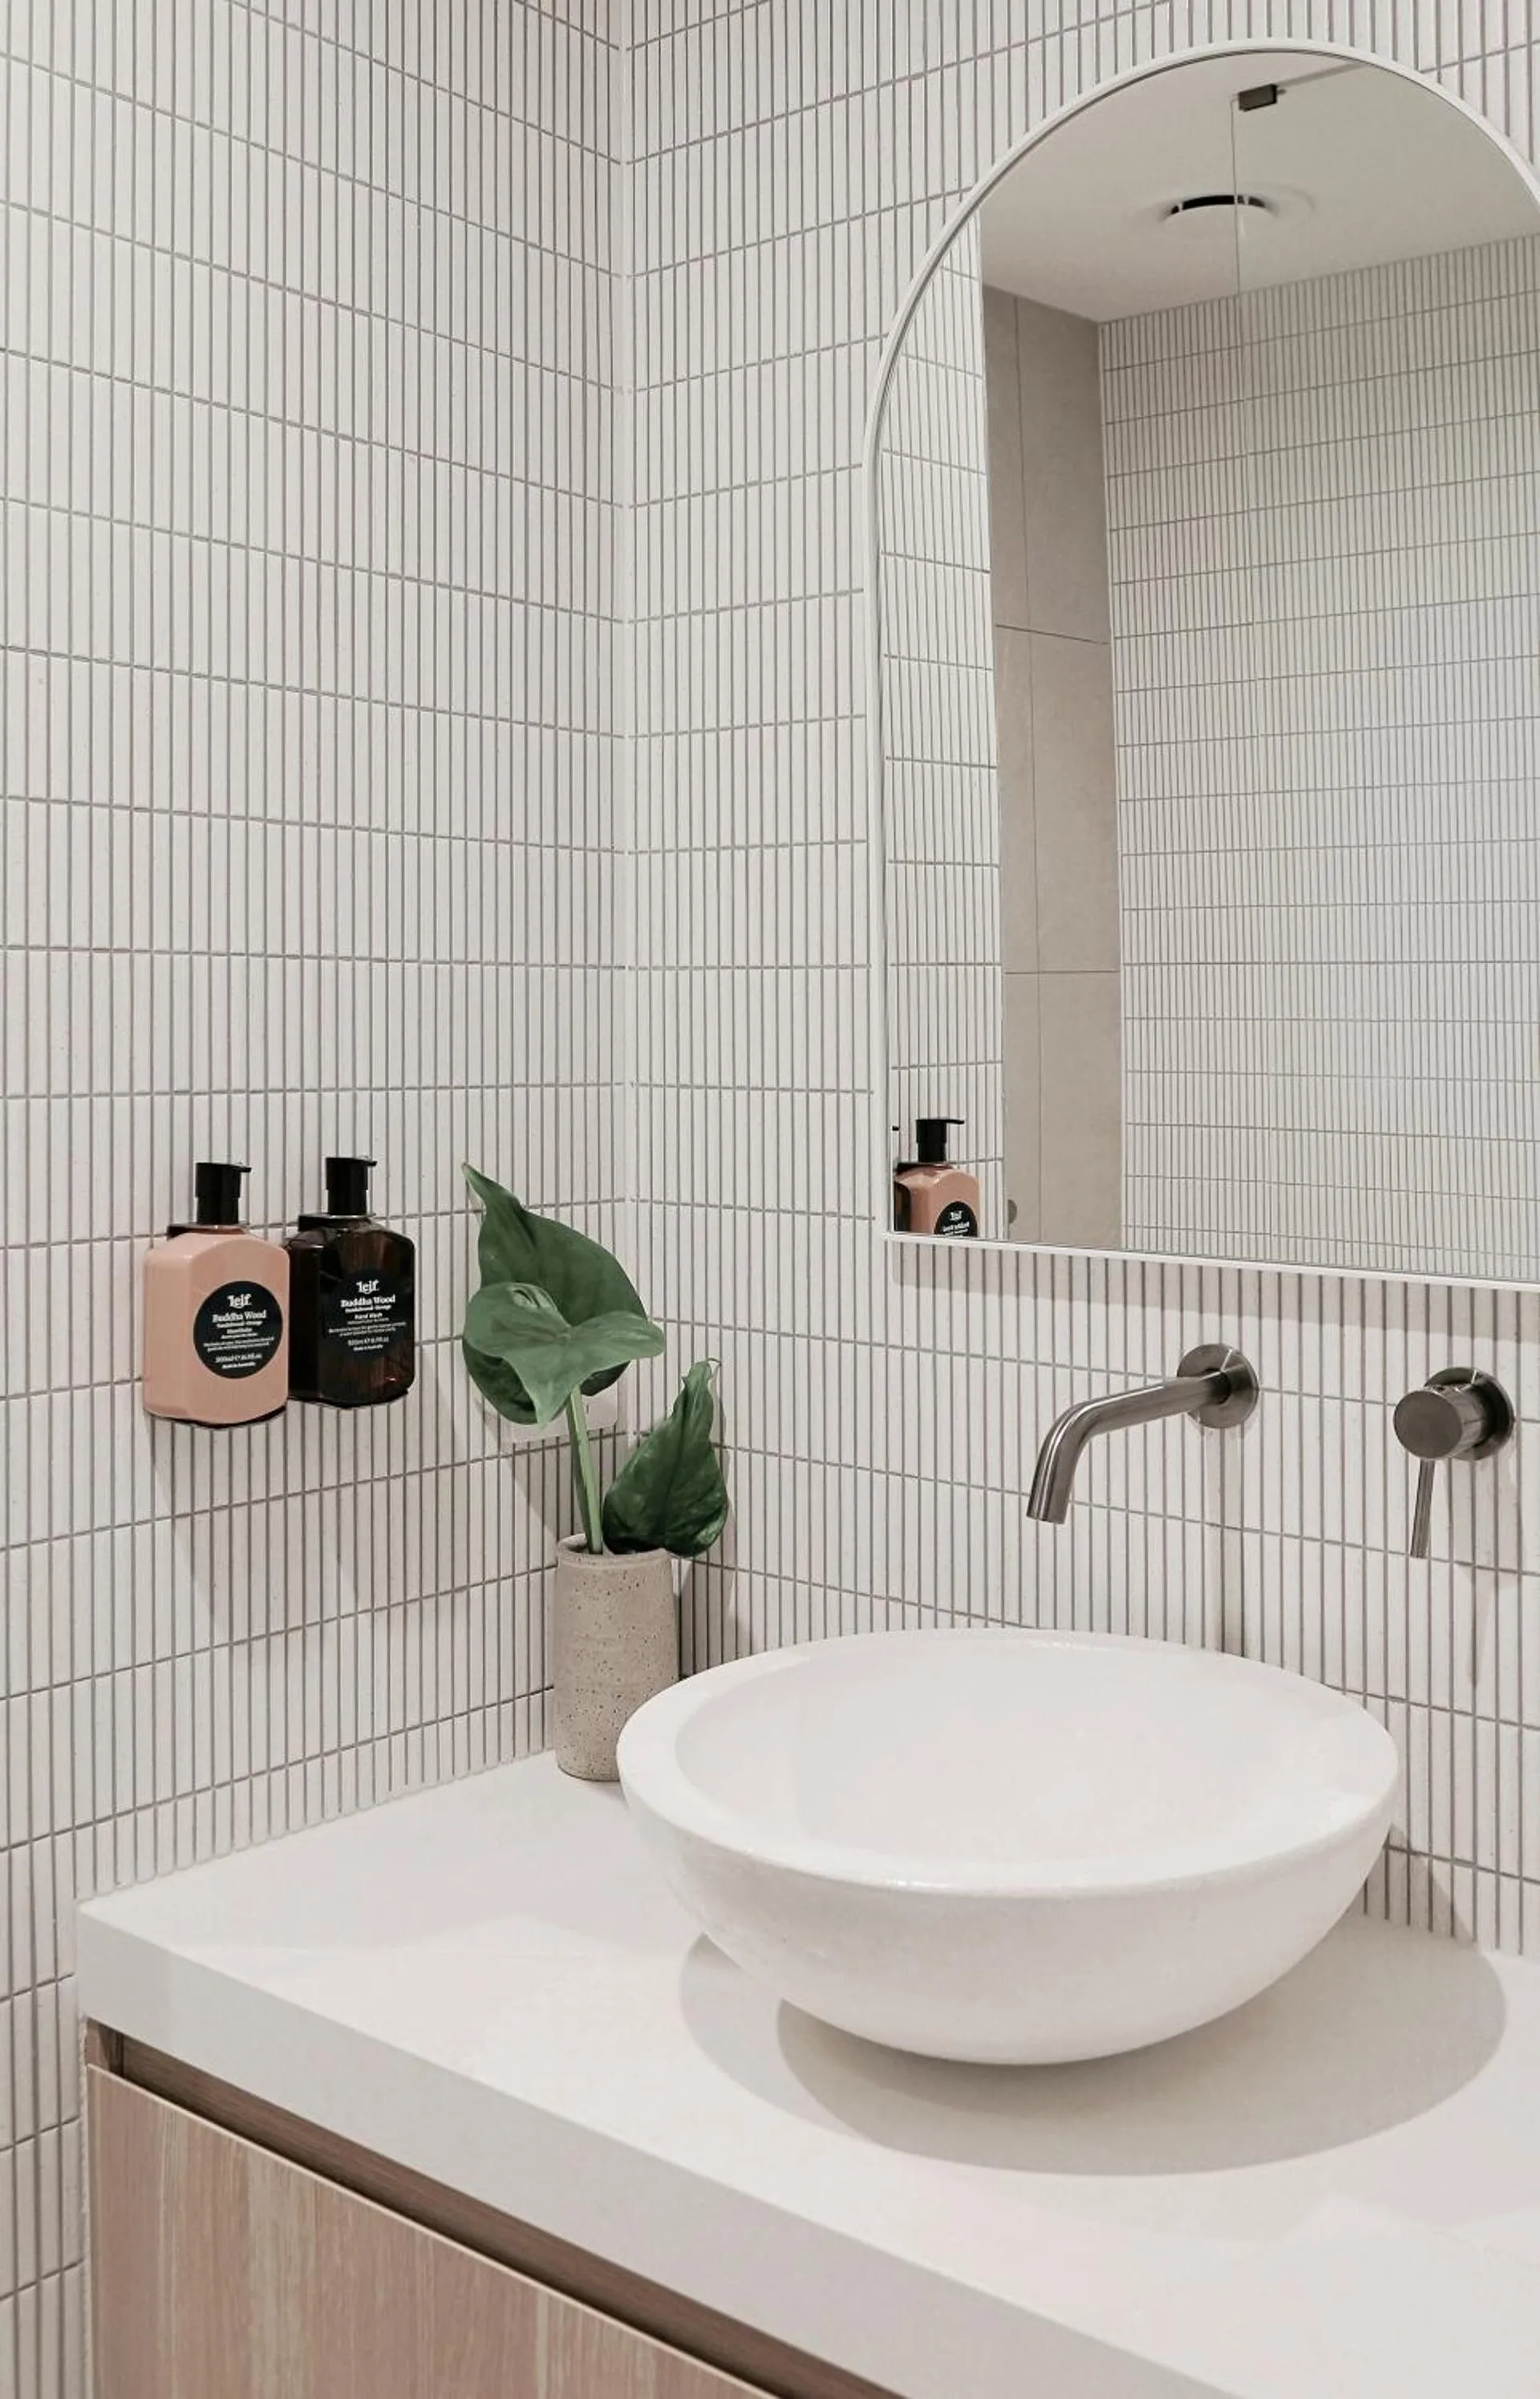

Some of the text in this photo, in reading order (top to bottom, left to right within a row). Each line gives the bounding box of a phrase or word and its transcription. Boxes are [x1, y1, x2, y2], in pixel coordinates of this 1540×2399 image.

[340, 1294, 395, 1307] Buddha Wood
[213, 1310, 266, 1323] Buddha Wood
